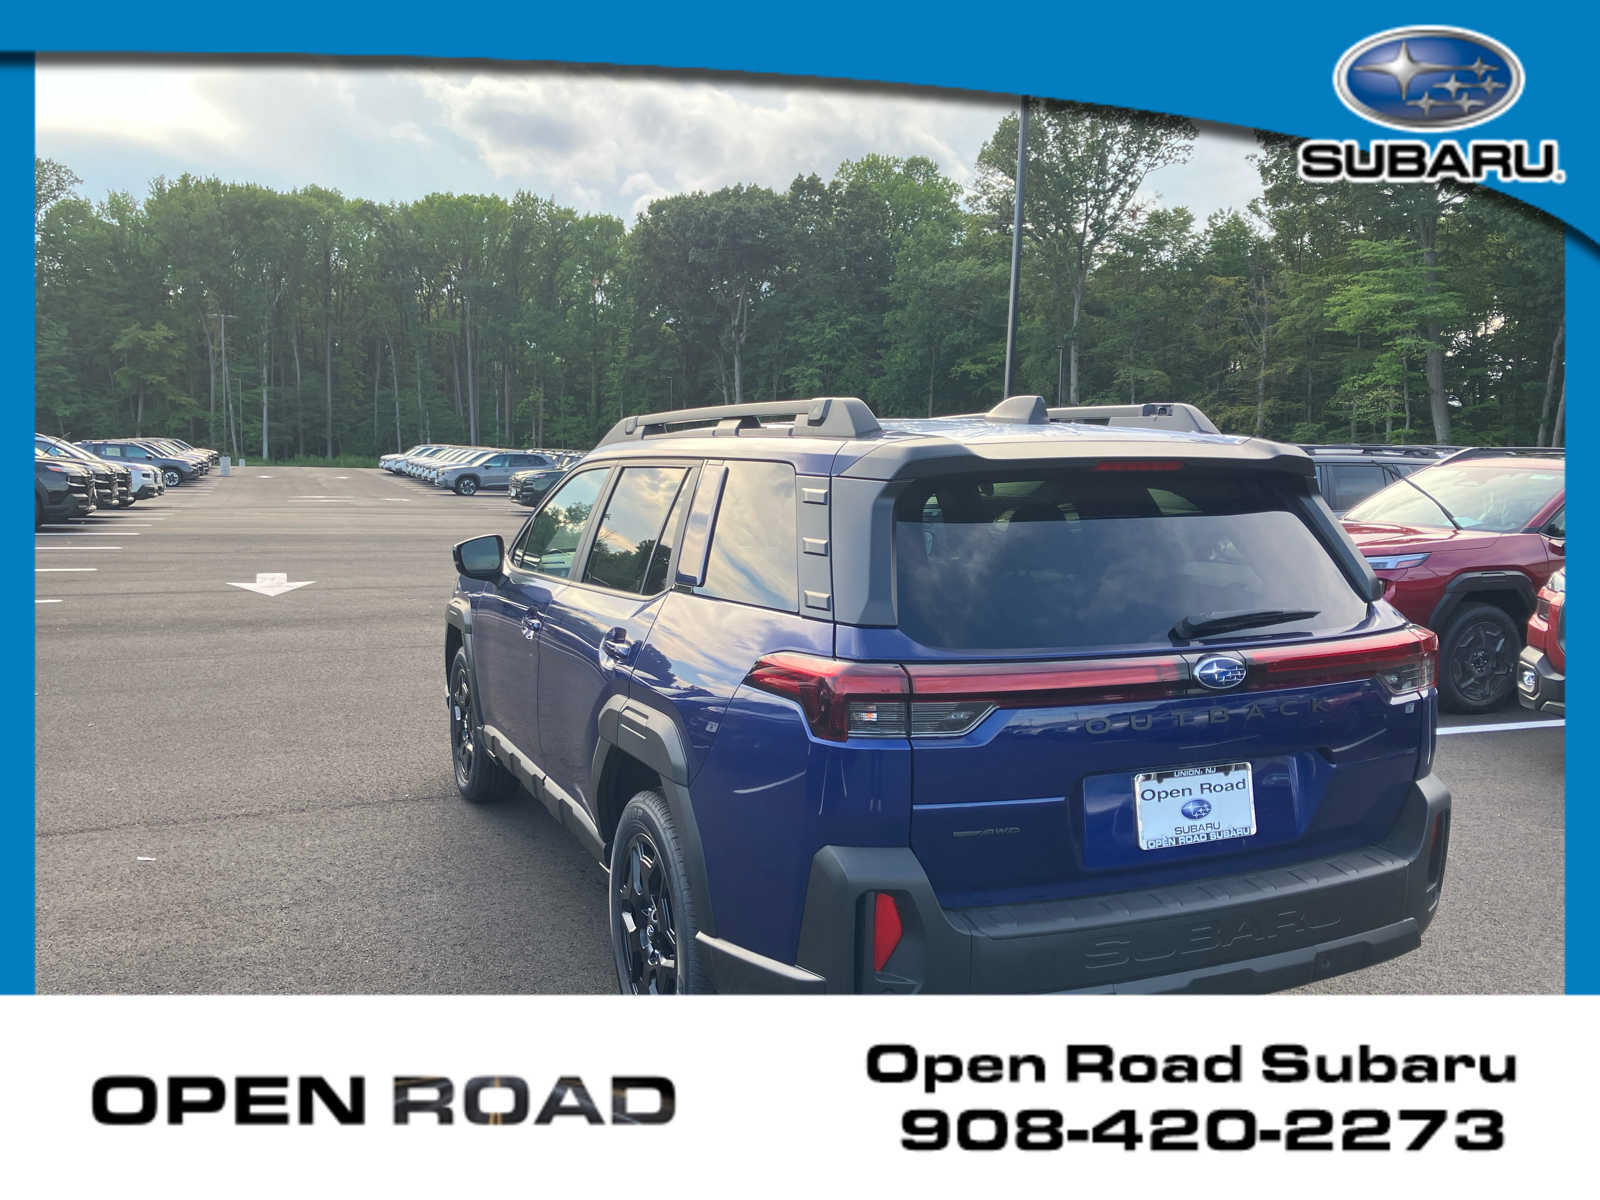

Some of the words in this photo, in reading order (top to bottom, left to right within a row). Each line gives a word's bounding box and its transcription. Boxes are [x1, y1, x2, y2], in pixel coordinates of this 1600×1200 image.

[1085, 698, 1329, 734] OUTBACK
[1205, 767, 1217, 775] NJ
[1141, 787, 1192, 802] Open
[1200, 779, 1246, 795] Road
[1147, 838, 1176, 849] OPEN
[1179, 832, 1207, 845] ROAD
[1209, 826, 1250, 840] SUBARU
[1174, 822, 1221, 835] SUBARU
